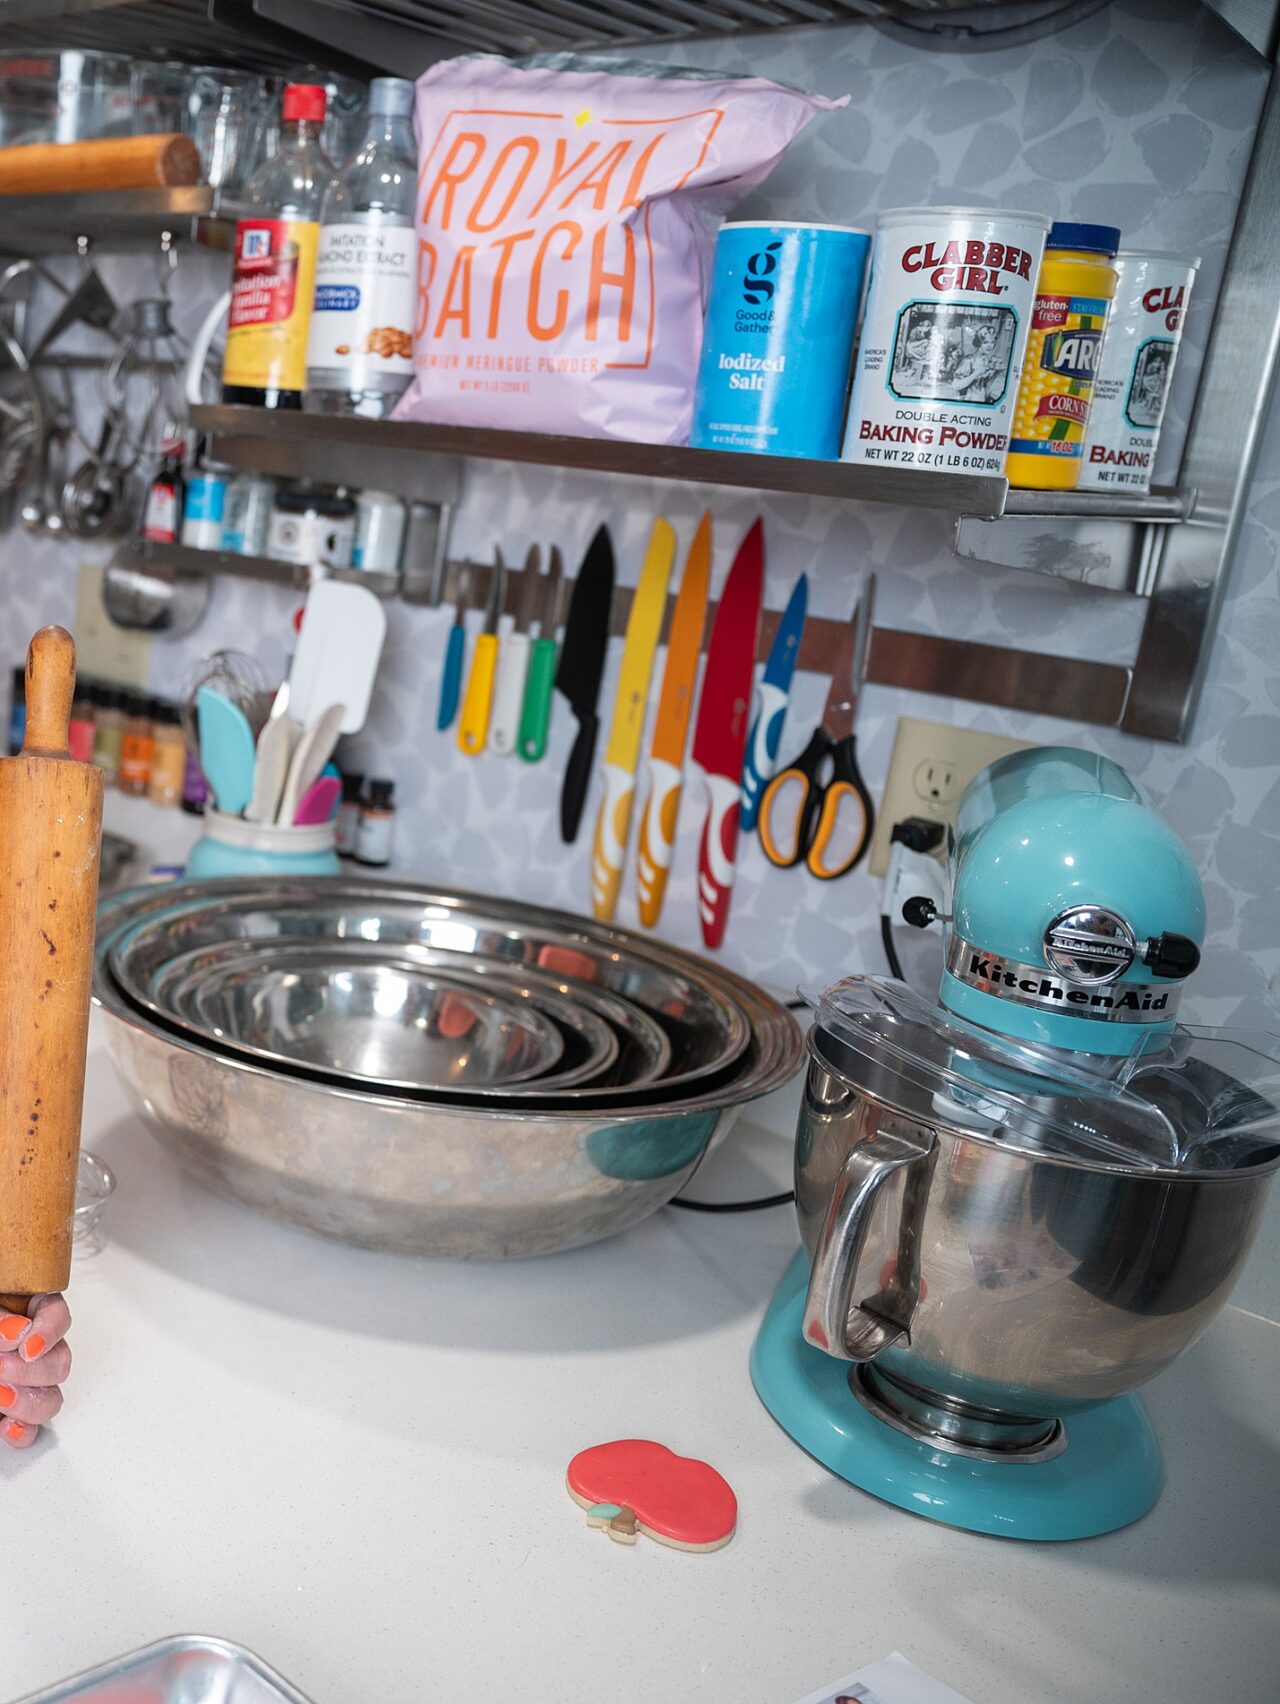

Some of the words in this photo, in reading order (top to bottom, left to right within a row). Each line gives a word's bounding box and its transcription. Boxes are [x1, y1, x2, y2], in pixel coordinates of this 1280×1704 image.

[422, 131, 666, 234] ROYAL
[902, 240, 1033, 281] CLABBER
[416, 219, 637, 342] BATCH
[930, 267, 1005, 295] GIRL
[736, 309, 767, 321] Good
[1033, 299, 1069, 311] gluten-
[1039, 310, 1063, 322] free
[466, 354, 531, 373] MERINGUE
[538, 356, 599, 374] POWDER
[718, 352, 786, 373] Iodized
[729, 373, 765, 391] Salt
[1049, 395, 1079, 414] CORN
[895, 411, 948, 423] DOUBLE
[950, 415, 992, 426] ACTING
[859, 420, 934, 445] BAKING
[865, 448, 880, 459] NET
[884, 449, 899, 461] WT
[901, 451, 914, 463] 22
[918, 453, 931, 464] OZ
[934, 453, 944, 467] (1
[948, 454, 961, 466] LB
[962, 456, 969, 467] 6
[971, 457, 986, 470] OZ)
[1089, 445, 1150, 467] BAKING
[1098, 471, 1116, 482] NET
[1118, 473, 1130, 483] WT
[968, 956, 1169, 1010] KitchenAid
